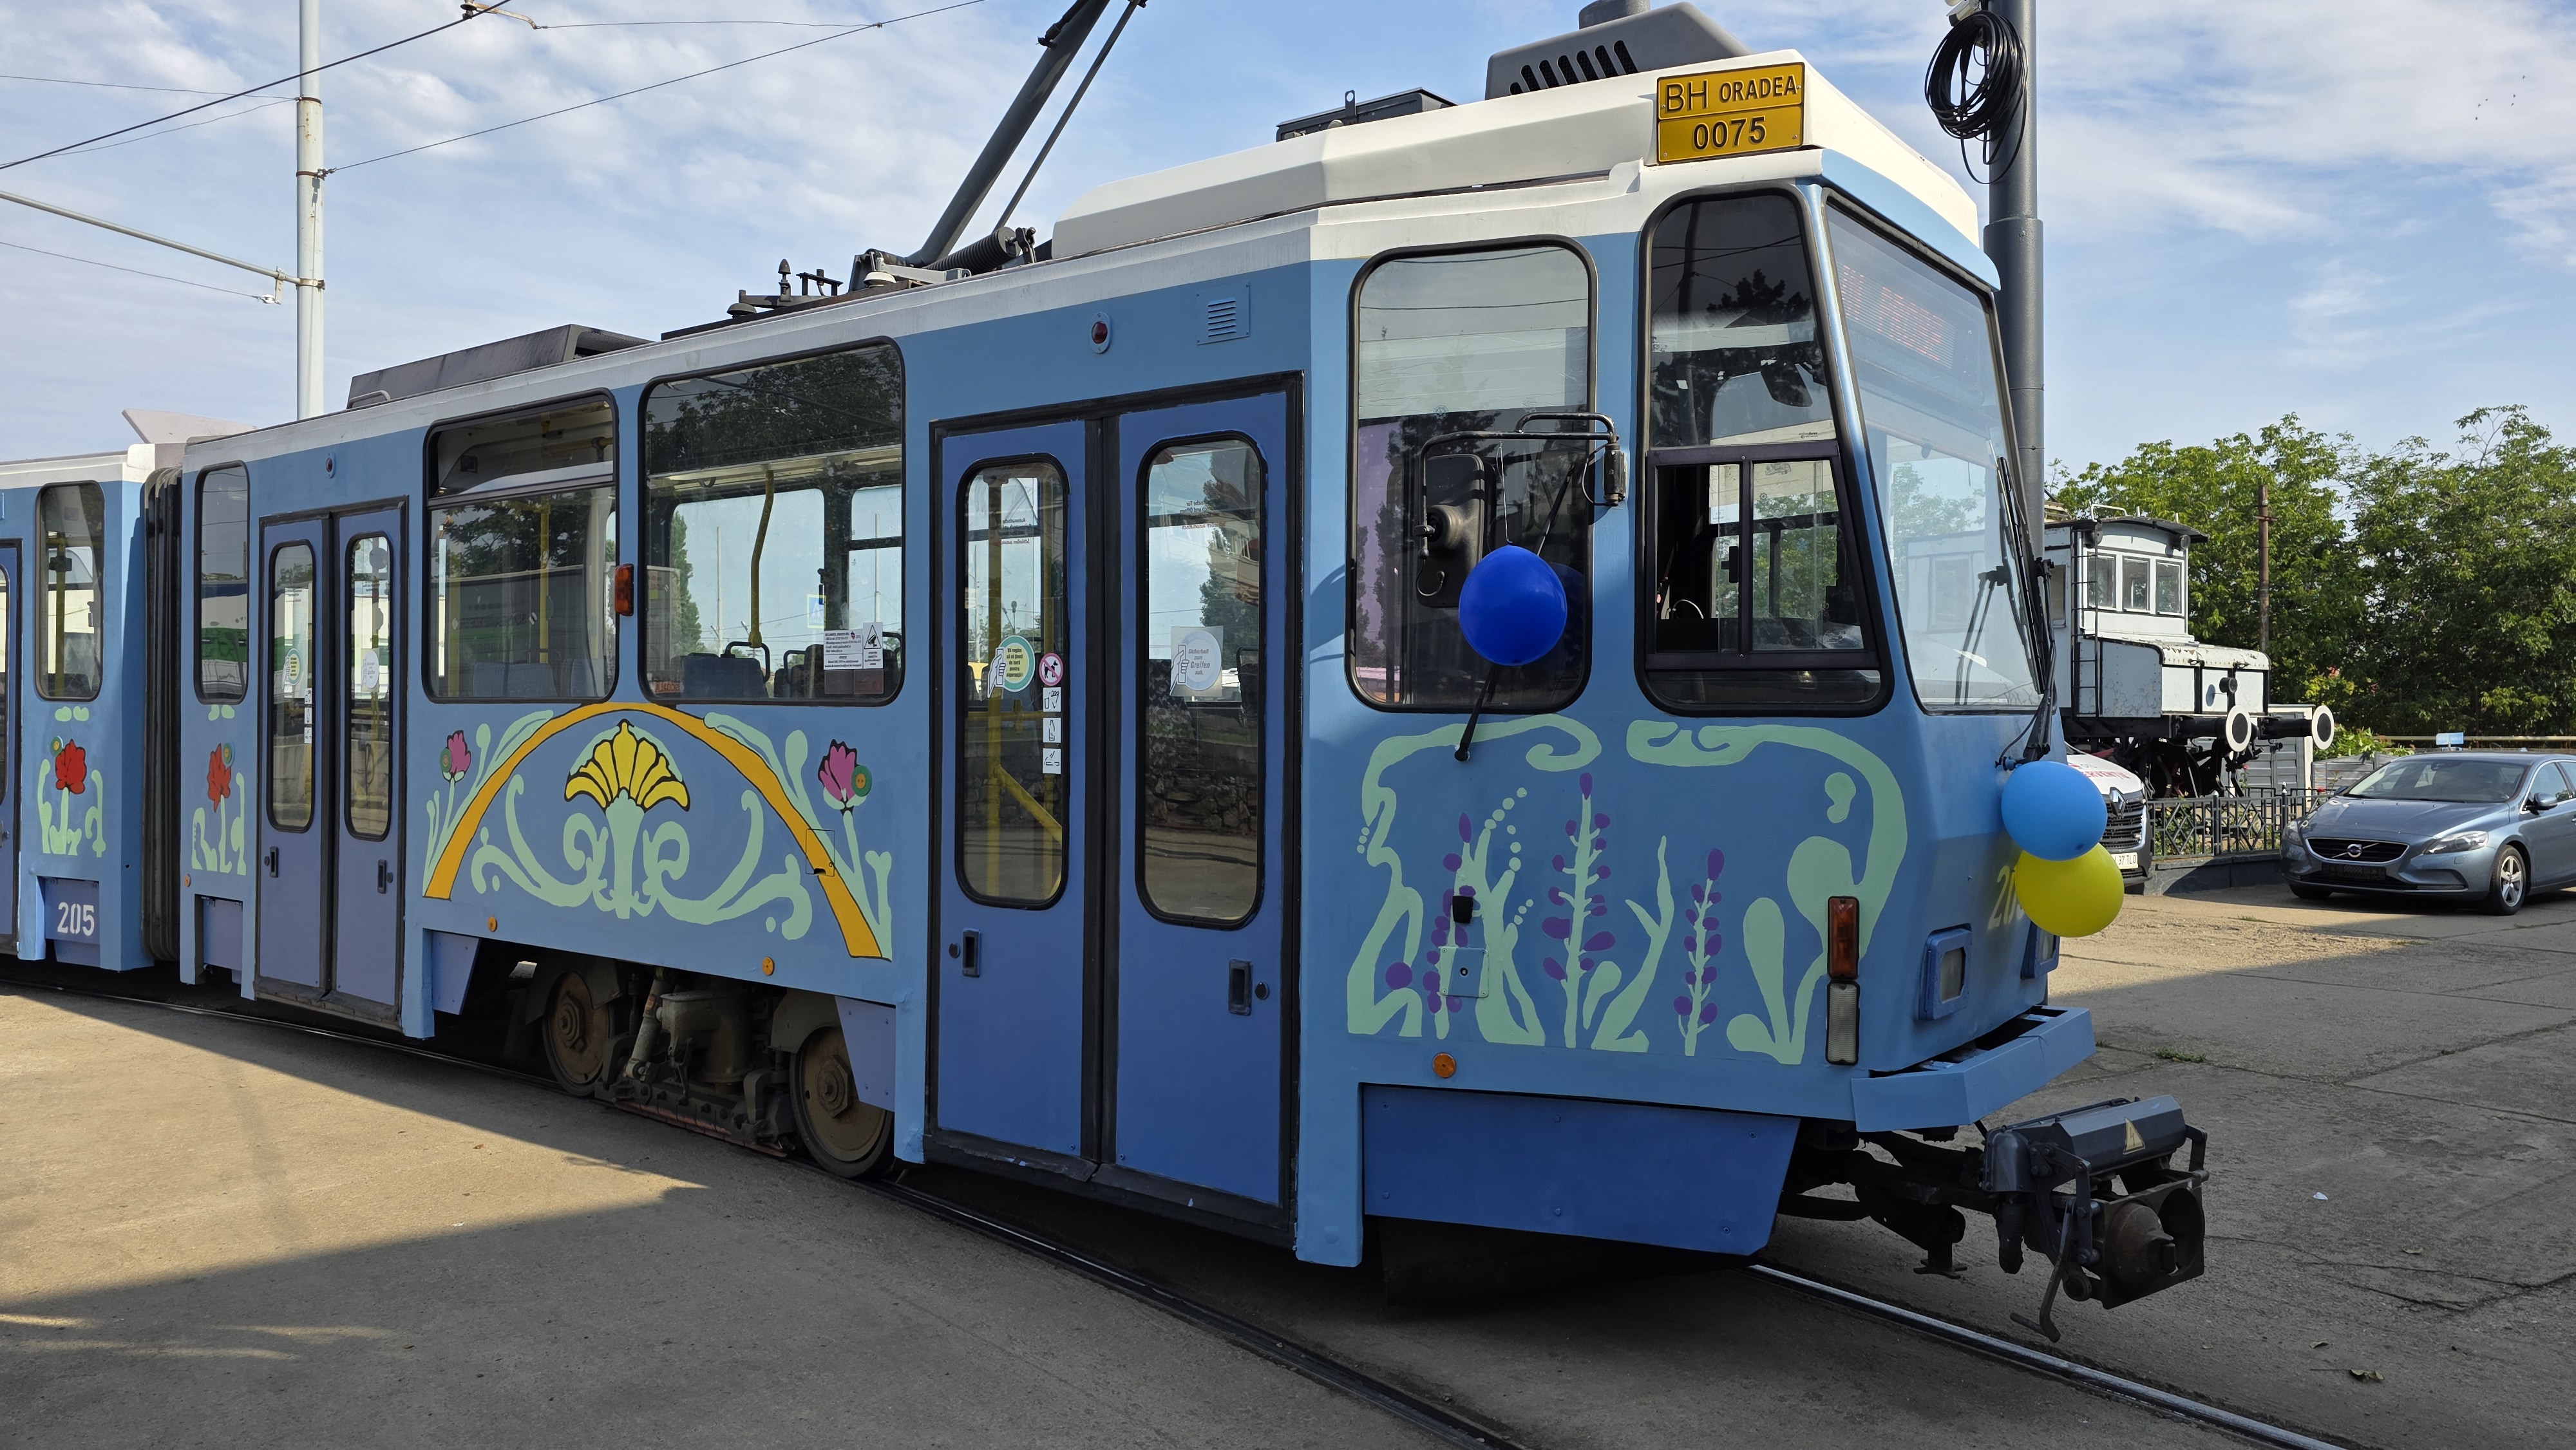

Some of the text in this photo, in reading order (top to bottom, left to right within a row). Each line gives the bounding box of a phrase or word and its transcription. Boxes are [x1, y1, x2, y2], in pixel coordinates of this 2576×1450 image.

[1665, 74, 1798, 113] BH ORADEA
[1692, 115, 1767, 150] 0075
[2118, 855, 2125, 865] 37
[2126, 854, 2137, 865] TLO
[1988, 865, 2024, 930] 20
[57, 901, 95, 936] 205
